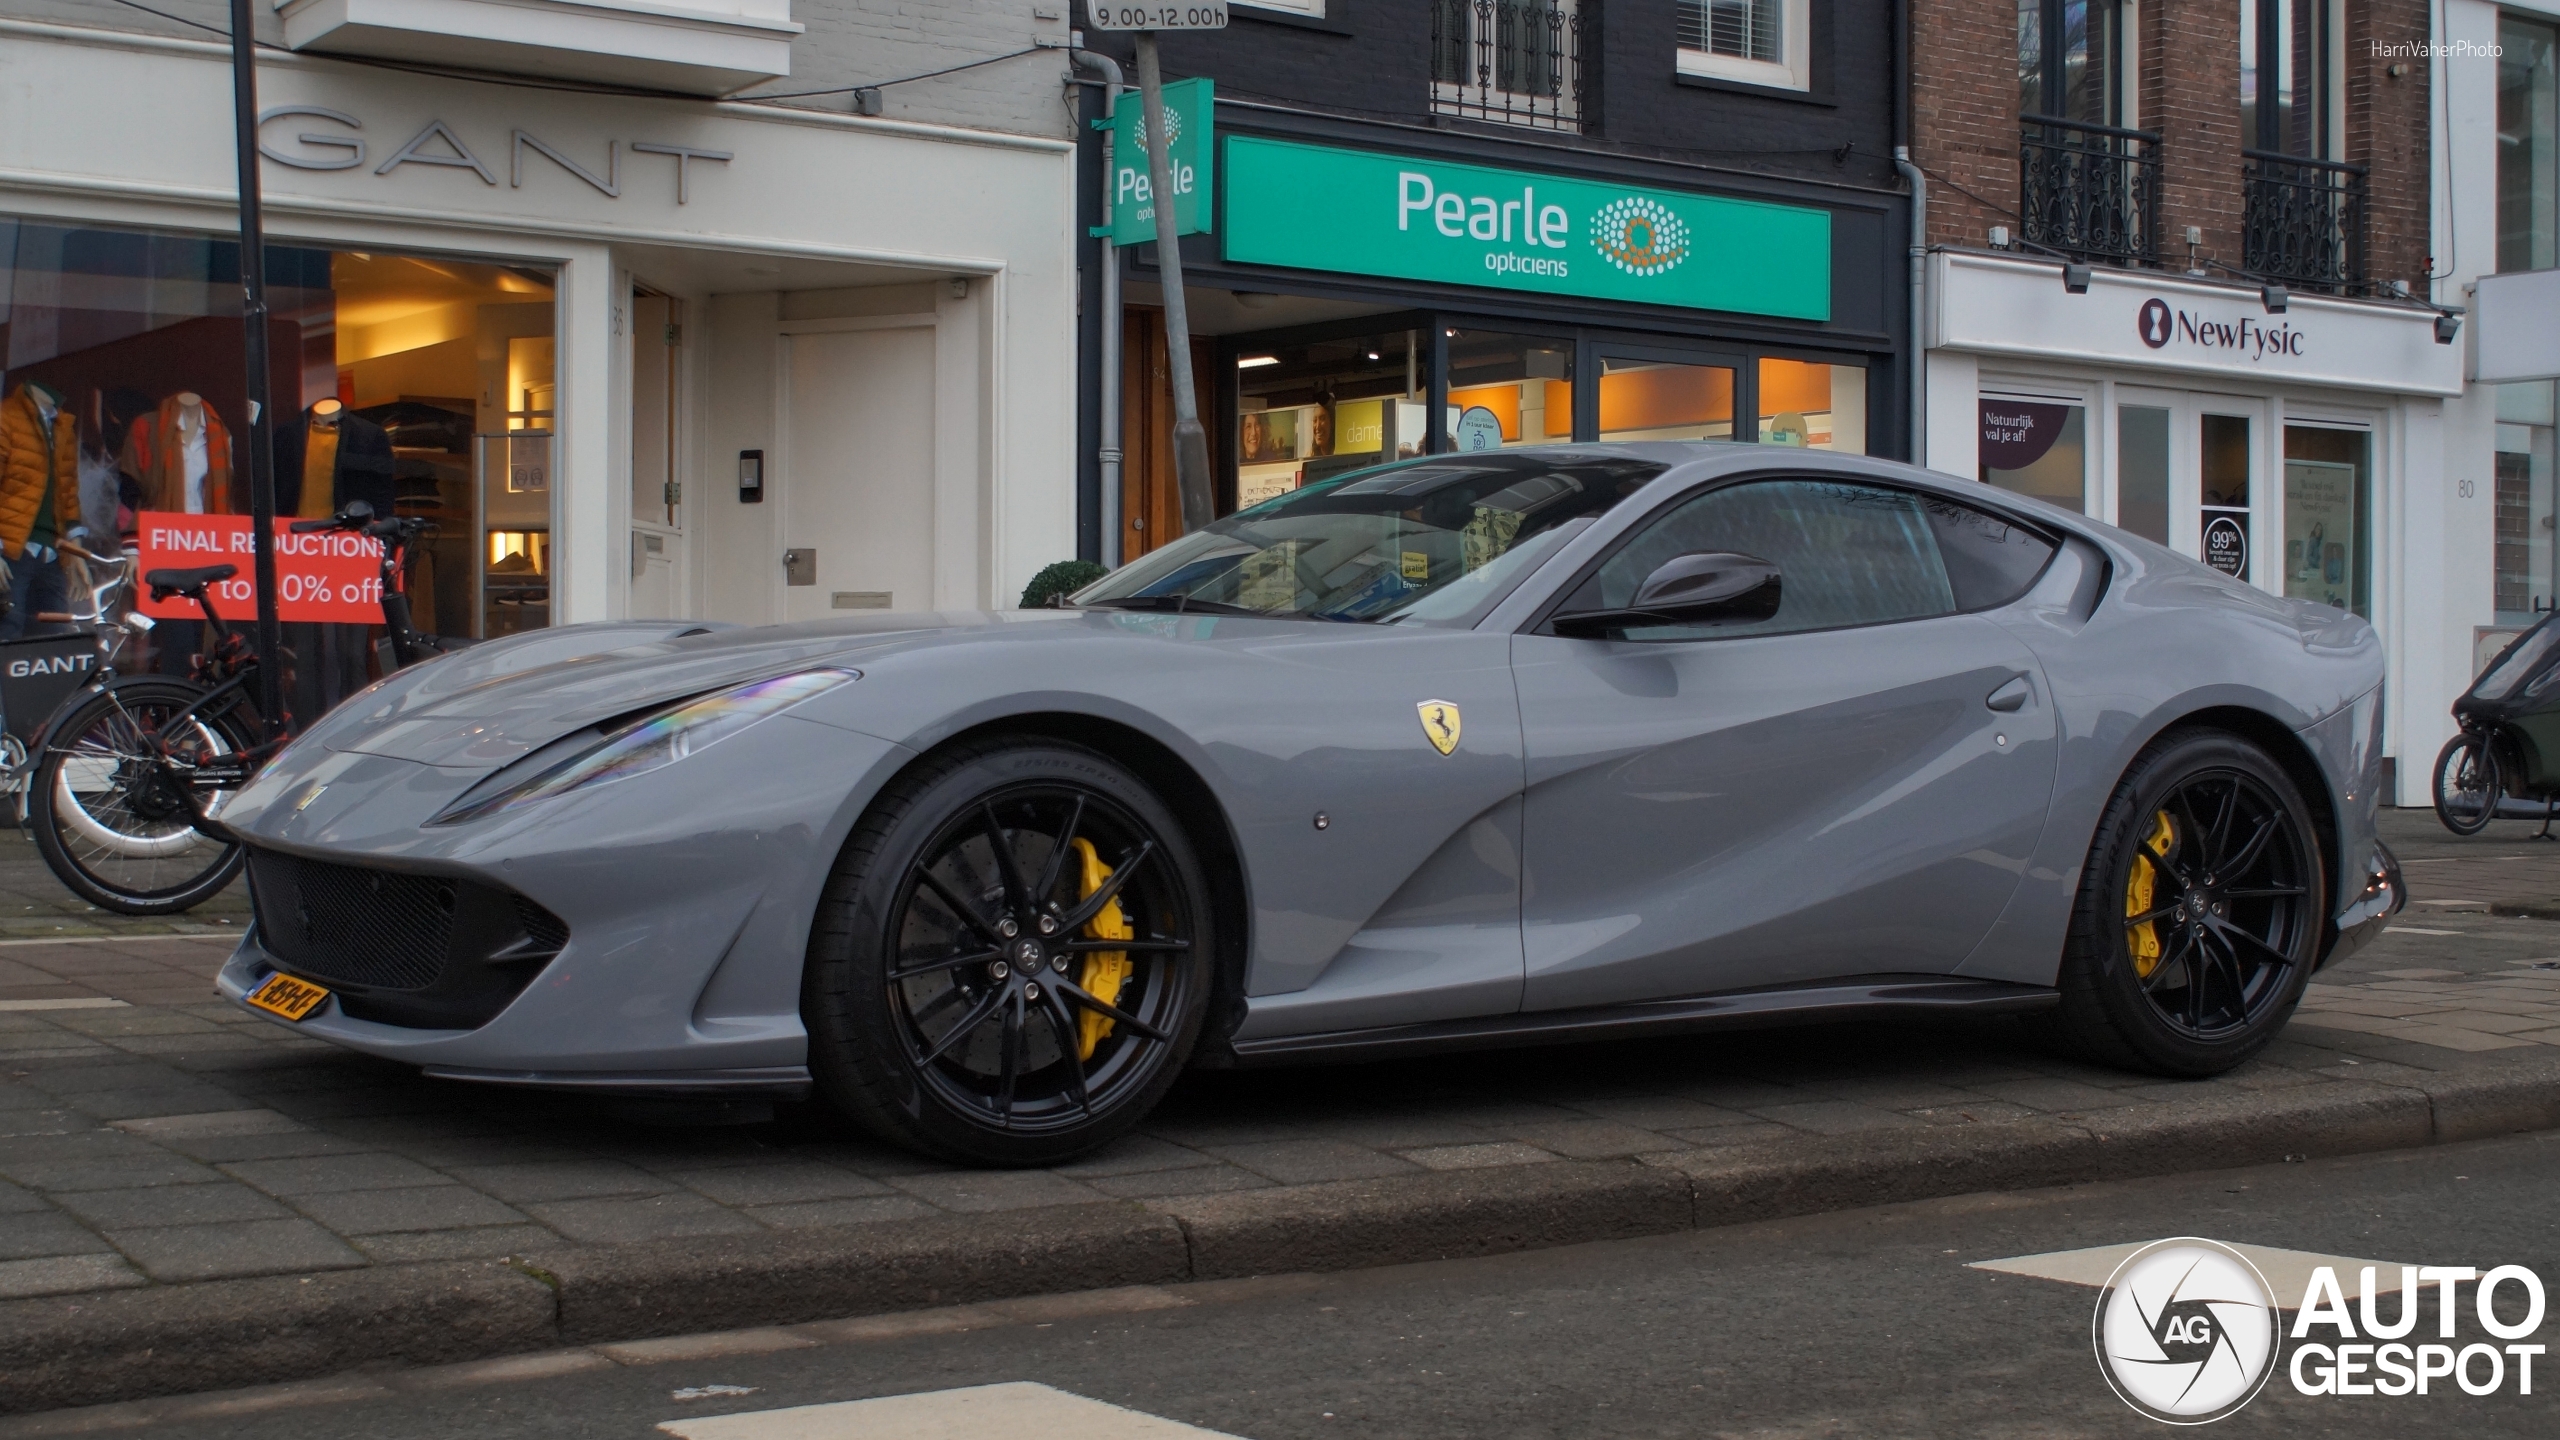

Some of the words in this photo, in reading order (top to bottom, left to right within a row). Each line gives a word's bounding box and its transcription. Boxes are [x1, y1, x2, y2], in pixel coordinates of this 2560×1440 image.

[1098, 7, 1226, 27] 9.00-12.00h
[258, 104, 735, 206] GANT
[1118, 158, 1194, 205] Pele
[1398, 171, 1569, 249] Pearle
[1485, 251, 1569, 278] opticiens
[2178, 308, 2305, 361] NewFysic
[1985, 412, 2035, 430] Natuurlijk
[1985, 427, 2000, 441] val
[2001, 428, 2011, 444] je
[2012, 430, 2026, 442] af!
[2458, 479, 2474, 499] 80
[152, 528, 224, 553] FINAL
[2212, 531, 2237, 549] 99%
[220, 578, 252, 601] to
[277, 573, 332, 603] 0%
[341, 577, 383, 604] off
[10, 653, 95, 678] GANT
